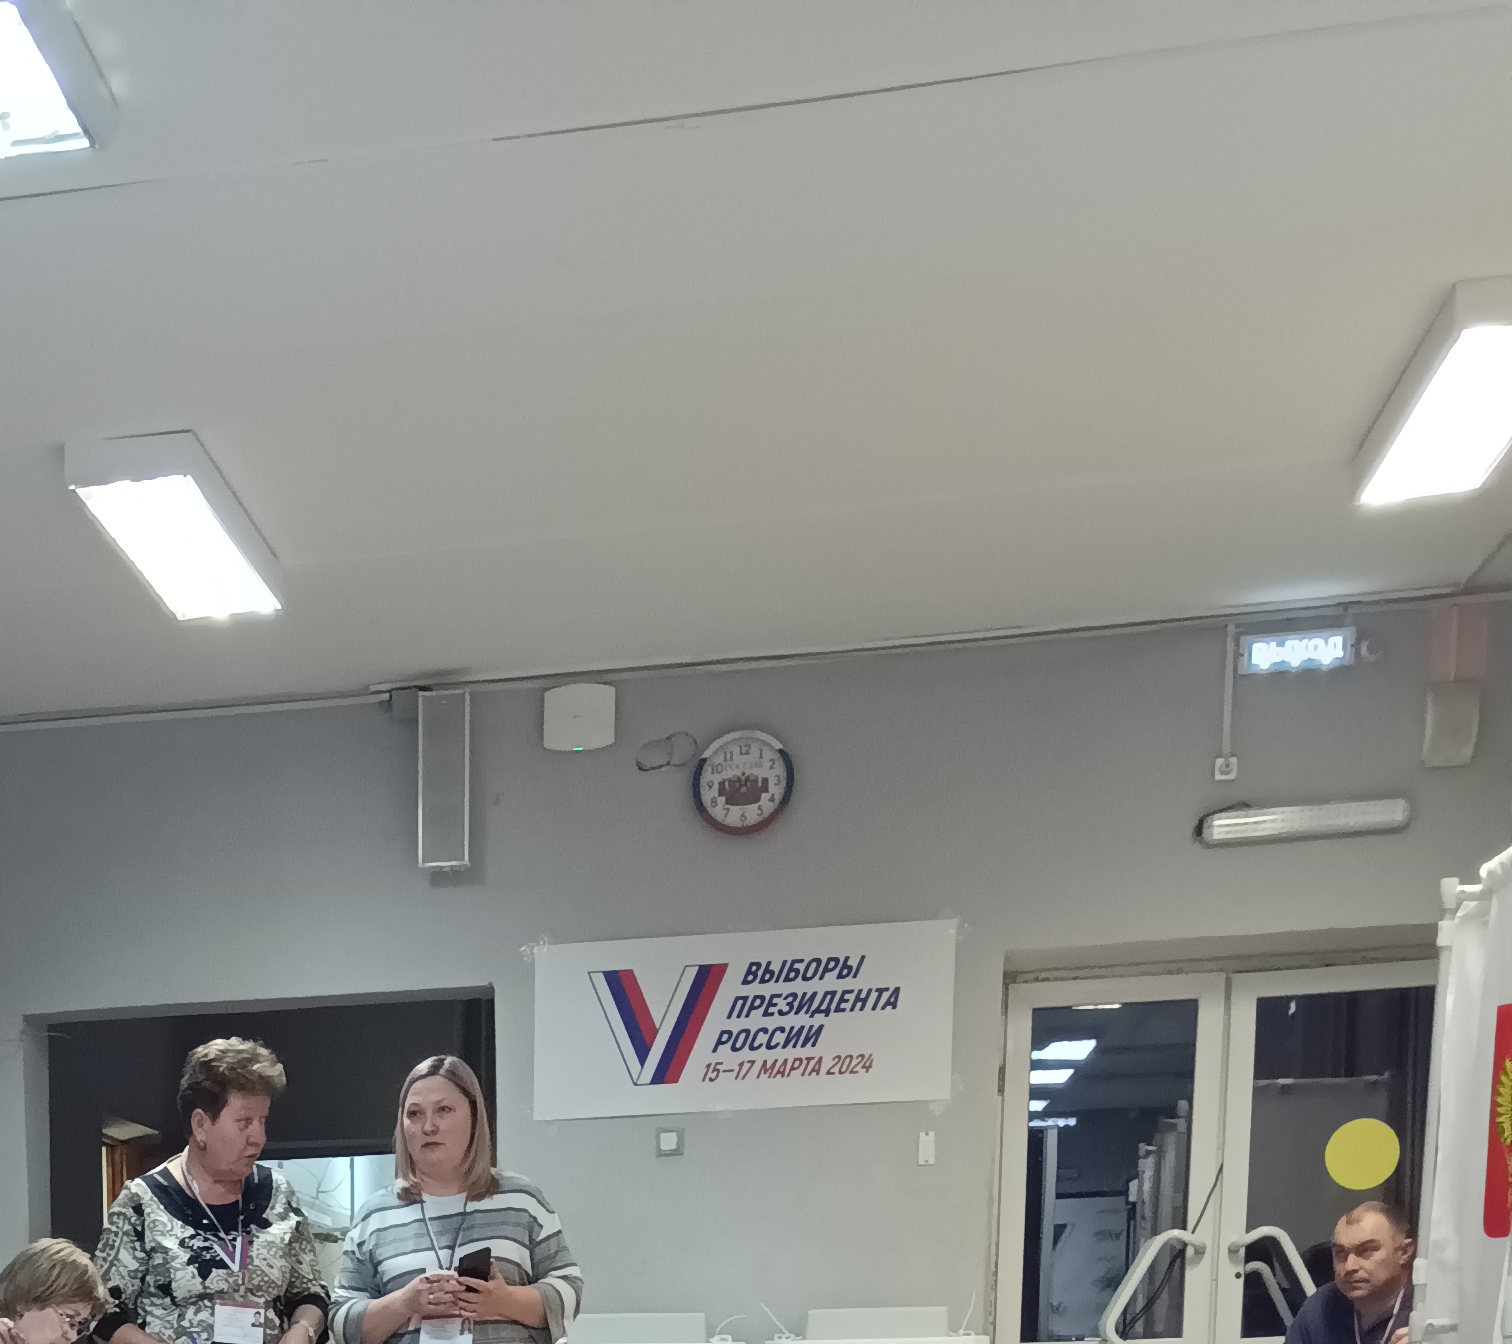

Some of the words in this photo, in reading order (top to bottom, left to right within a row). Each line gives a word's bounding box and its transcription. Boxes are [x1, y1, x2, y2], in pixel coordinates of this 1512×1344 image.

[1251, 635, 1344, 667] ВЫХОД
[723, 750, 734, 762] 11
[739, 744, 752, 756] 12
[758, 748, 764, 760] 1
[710, 763, 724, 775] 10
[769, 758, 776, 770] 2
[740, 954, 867, 986] ВЫБОРЫ
[726, 986, 902, 1020] ПРЕЗИДЕНТА
[711, 1024, 825, 1054] РОССИИ
[756, 1056, 823, 1080] МАРТА
[826, 1053, 874, 1076] 2024
